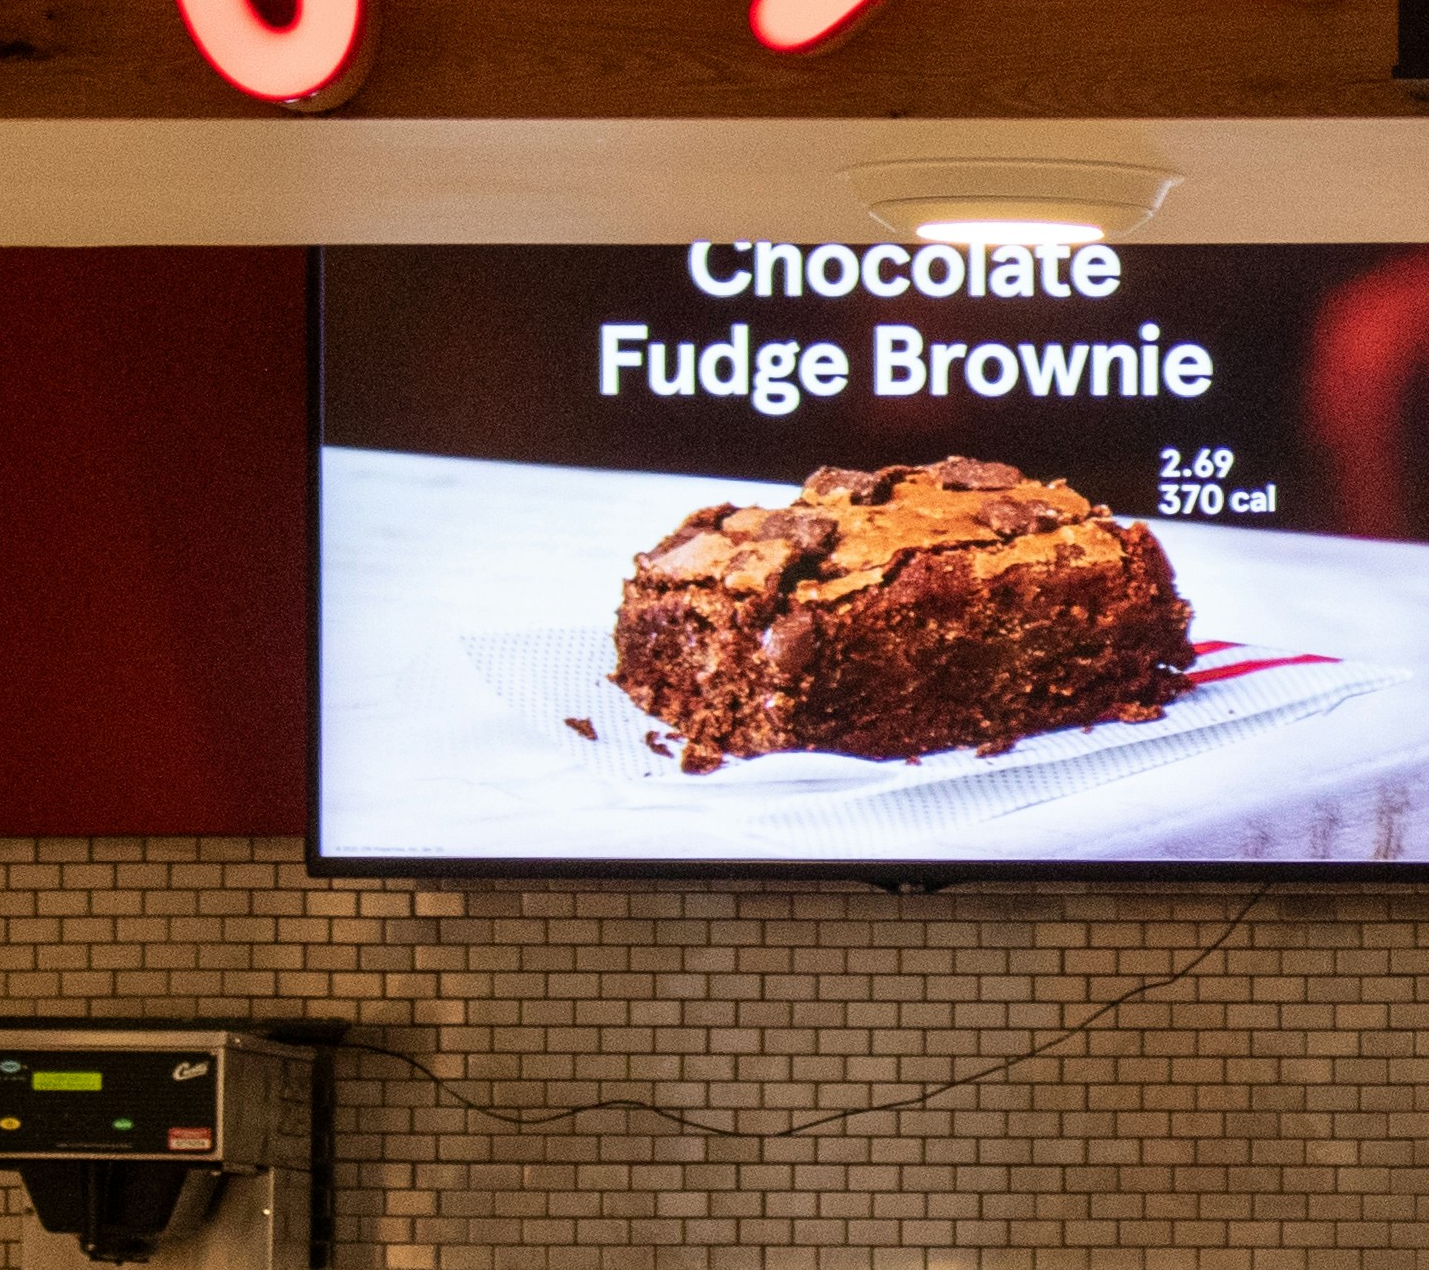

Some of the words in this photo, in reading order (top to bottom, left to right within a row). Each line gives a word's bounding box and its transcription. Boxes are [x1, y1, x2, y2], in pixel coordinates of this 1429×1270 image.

[688, 244, 1121, 299] Chocolate
[599, 326, 849, 415] Fudge
[874, 323, 1214, 398] Brownie
[1160, 451, 1235, 479] 2.69
[1160, 486, 1223, 515] 370
[1230, 486, 1277, 514] cal
